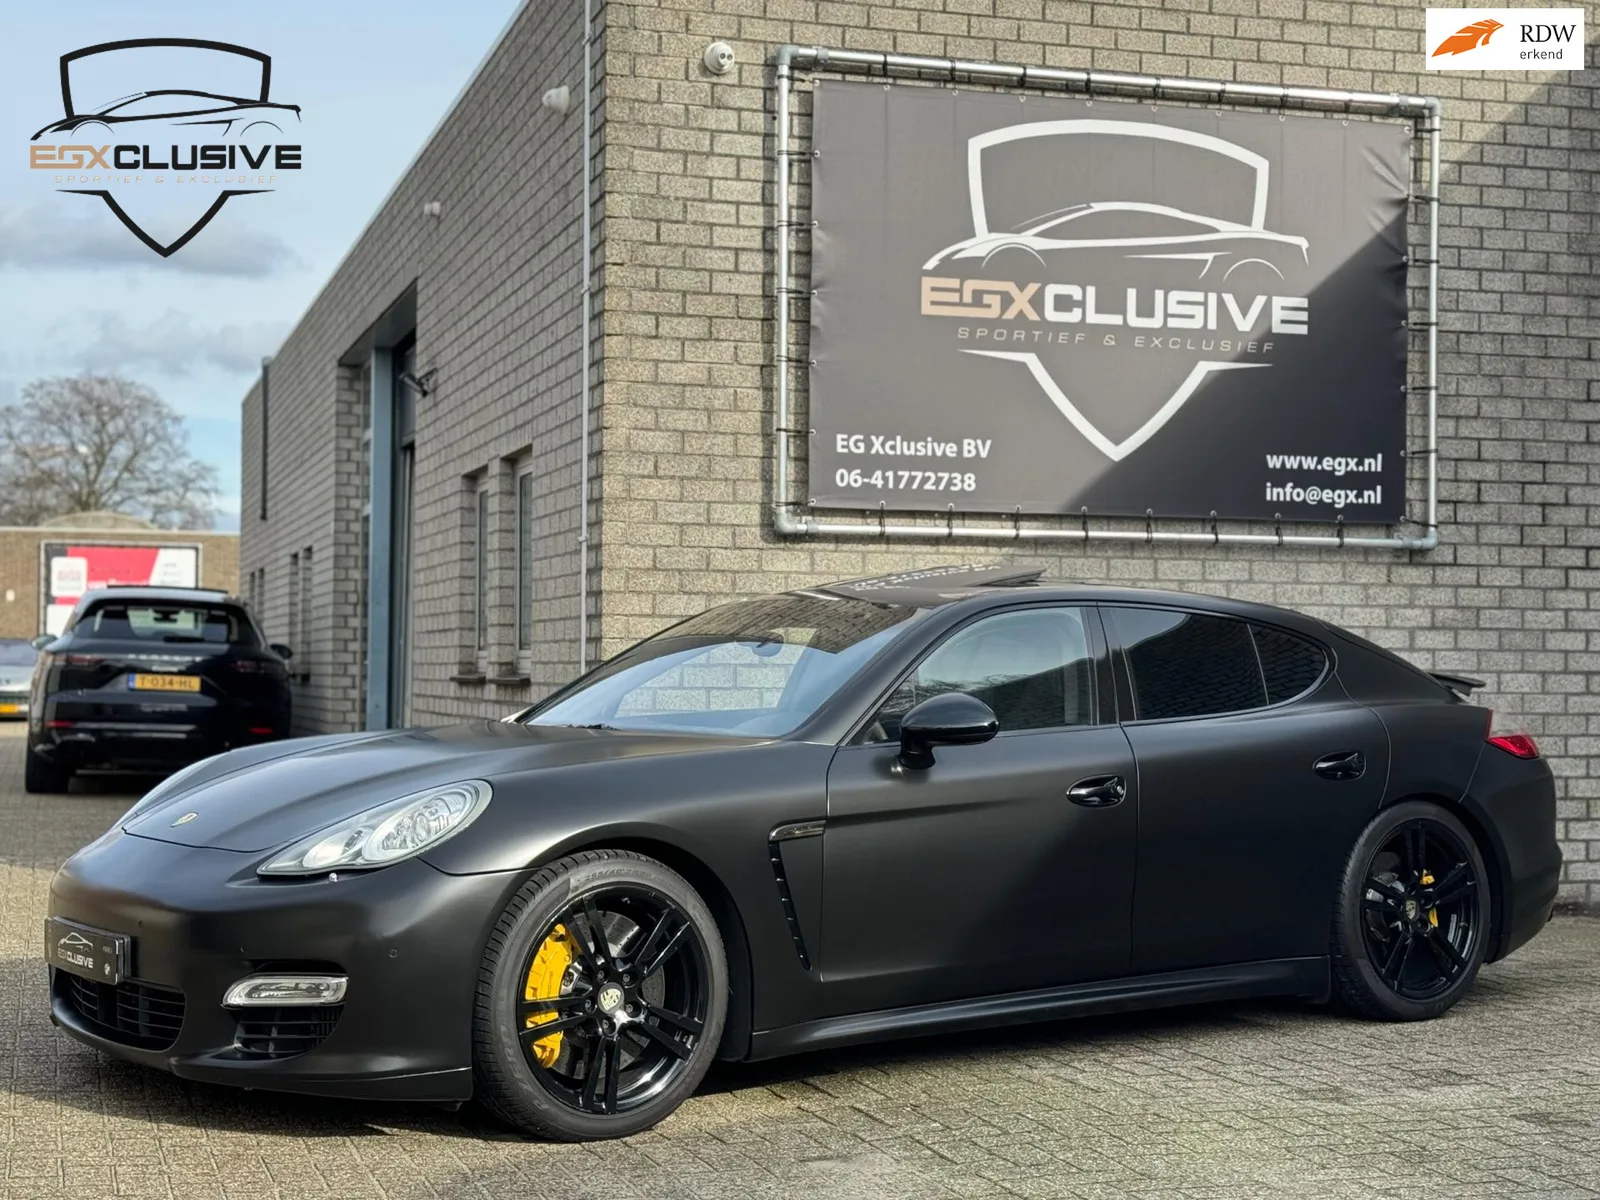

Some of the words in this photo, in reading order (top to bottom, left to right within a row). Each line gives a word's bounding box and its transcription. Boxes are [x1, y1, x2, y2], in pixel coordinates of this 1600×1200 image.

[921, 276, 1309, 335] EGXCLUSIVE
[957, 327, 1086, 344] SPORTIEF
[1103, 334, 1116, 346] &
[1134, 336, 1275, 353] EXCLUSIEF
[836, 434, 865, 454] EG
[870, 435, 958, 457] Xclusive
[963, 438, 992, 458] BV
[1266, 453, 1383, 476] www.egx.nl
[836, 468, 976, 491] 06-41772738
[1266, 482, 1382, 508] info@egx.nl
